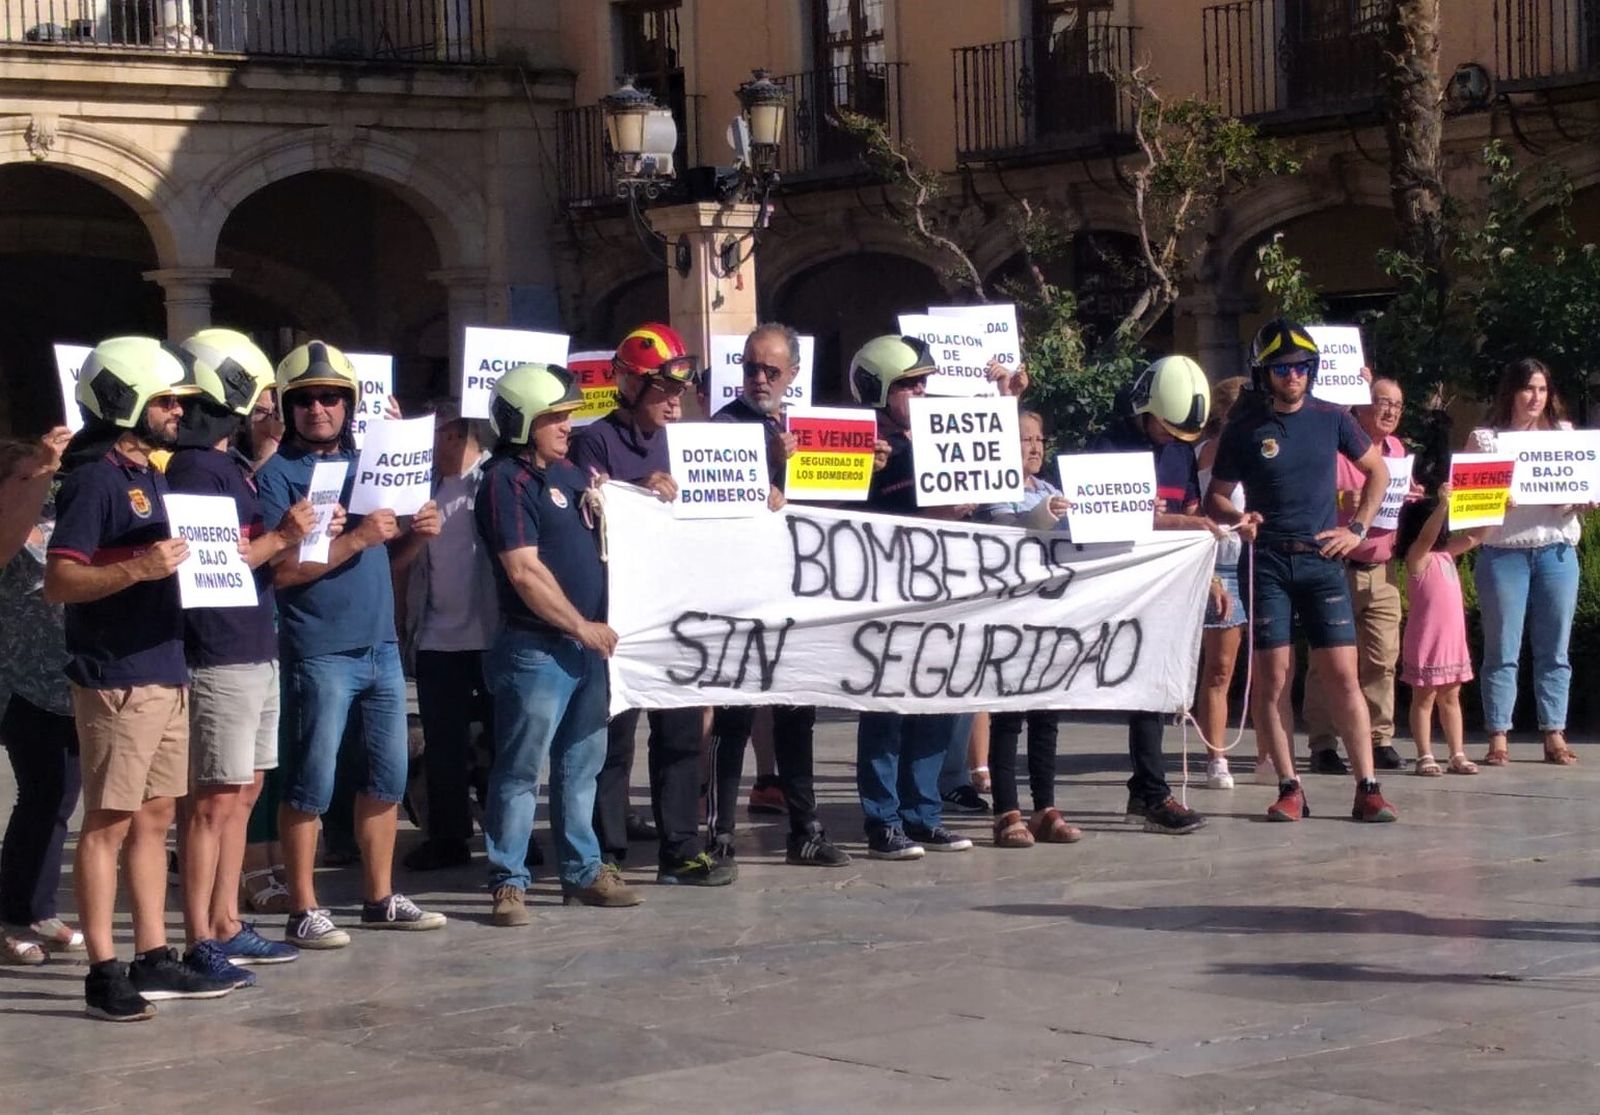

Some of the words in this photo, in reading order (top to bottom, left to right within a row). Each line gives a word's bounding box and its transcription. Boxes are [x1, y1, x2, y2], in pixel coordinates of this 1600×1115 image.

[919, 333, 983, 348] IOLACION
[943, 349, 961, 361] DE
[935, 364, 991, 378] UERDOS
[1321, 359, 1338, 370] DE
[1315, 374, 1364, 386] UERDOS
[929, 412, 1003, 434] BASTA
[818, 429, 875, 448] VENDE
[376, 448, 433, 467] ACUERD
[682, 449, 758, 463] DOTACION
[935, 443, 966, 463] YA
[973, 441, 1001, 462] DE
[1516, 450, 1597, 463] OMBEROS
[800, 456, 851, 467] SEGURIDAD
[854, 458, 865, 467] DE
[360, 469, 432, 487] PISOTEA
[688, 469, 743, 482] MINIMA
[749, 468, 757, 482] 5
[796, 470, 814, 480] LOS
[816, 470, 864, 481] BOMBEROS
[1453, 472, 1470, 486] SE
[1532, 466, 1574, 478] BAJO
[919, 468, 1020, 493] CORTIJO
[1520, 481, 1589, 493] MINIMOS
[681, 488, 766, 503] BOMBEROS
[1077, 482, 1151, 497] ACUERDOS
[1070, 499, 1155, 515] PISOTEADOS
[178, 526, 239, 543] BOMBEROS
[198, 549, 228, 565] BAJO
[785, 514, 1084, 602] BOMBEROS
[194, 572, 243, 588] MINIMOS
[666, 610, 796, 692] SIN
